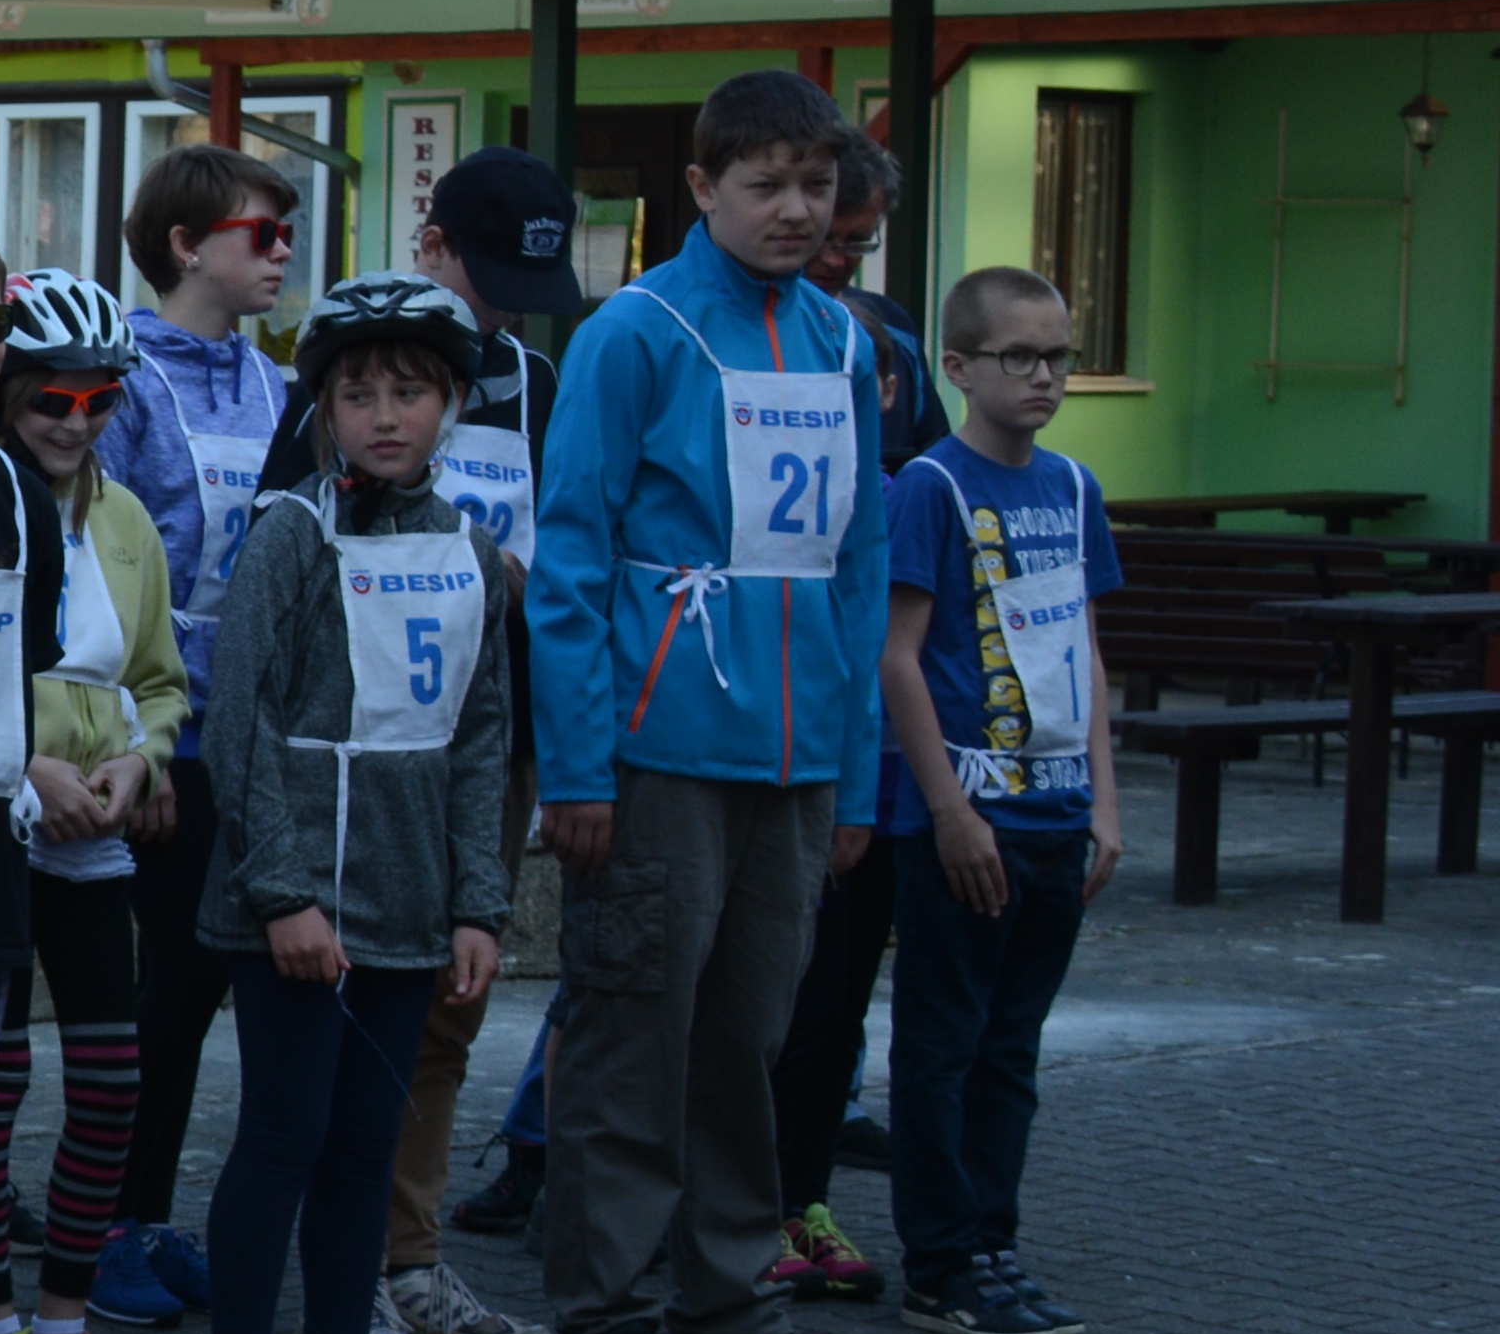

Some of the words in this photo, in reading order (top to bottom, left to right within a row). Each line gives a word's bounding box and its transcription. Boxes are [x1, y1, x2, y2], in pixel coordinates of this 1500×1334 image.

[759, 409, 846, 428] BESIP
[768, 452, 829, 536] 21
[378, 572, 475, 593] BESIP
[405, 618, 443, 705] 5
